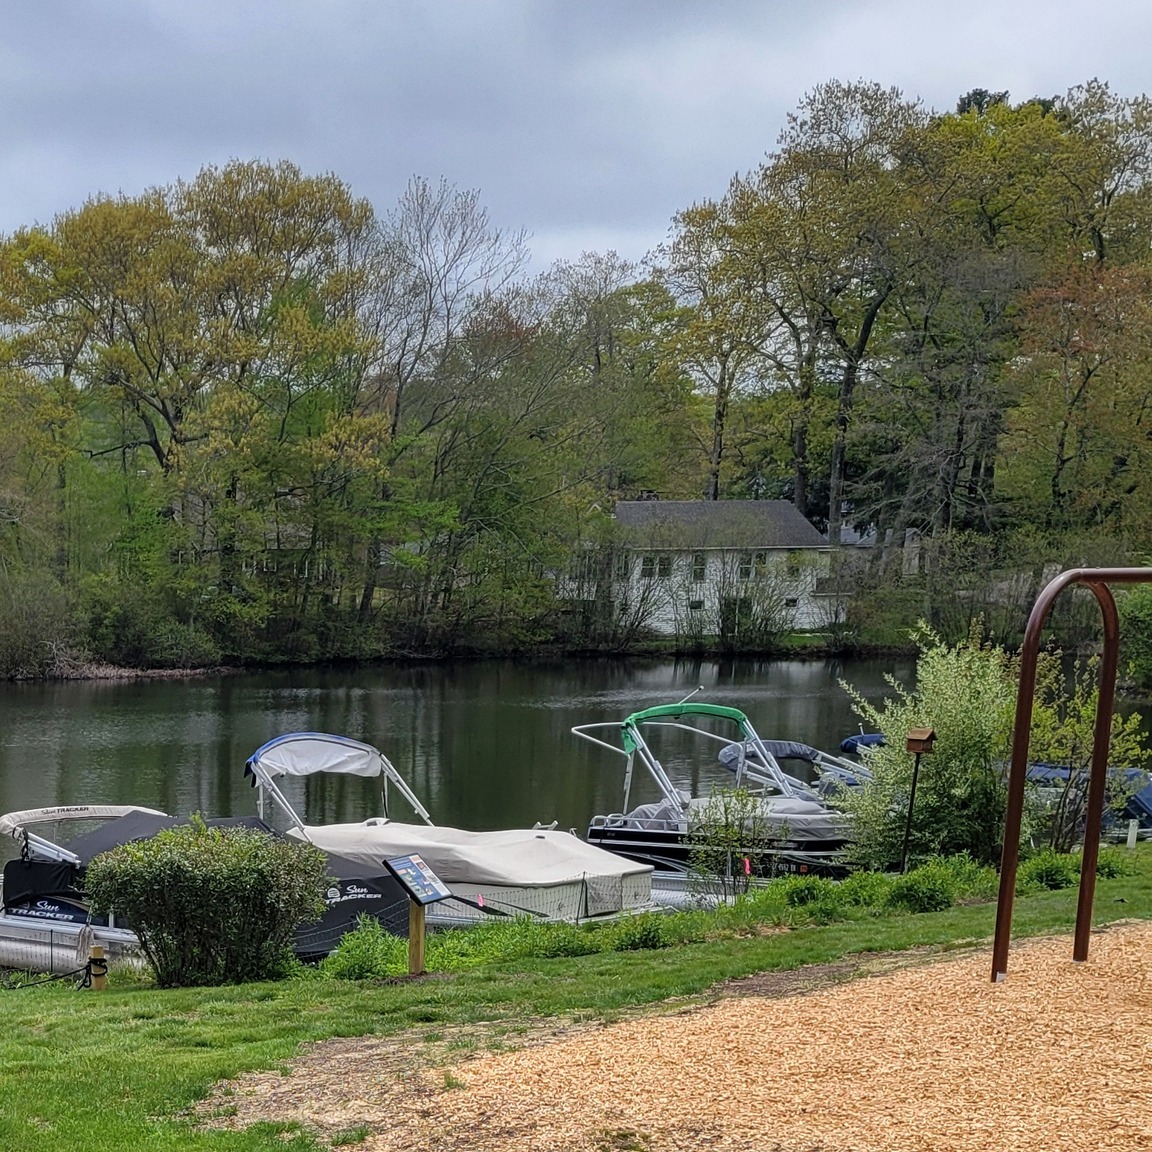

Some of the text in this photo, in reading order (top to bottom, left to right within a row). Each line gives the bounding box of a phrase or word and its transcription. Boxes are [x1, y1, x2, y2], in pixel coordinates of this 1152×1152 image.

[57, 806, 89, 814] TRACKER
[345, 884, 368, 894] Sun
[325, 893, 382, 904] TRACKER
[36, 900, 60, 911] Sun
[11, 908, 74, 920] TRACKER
